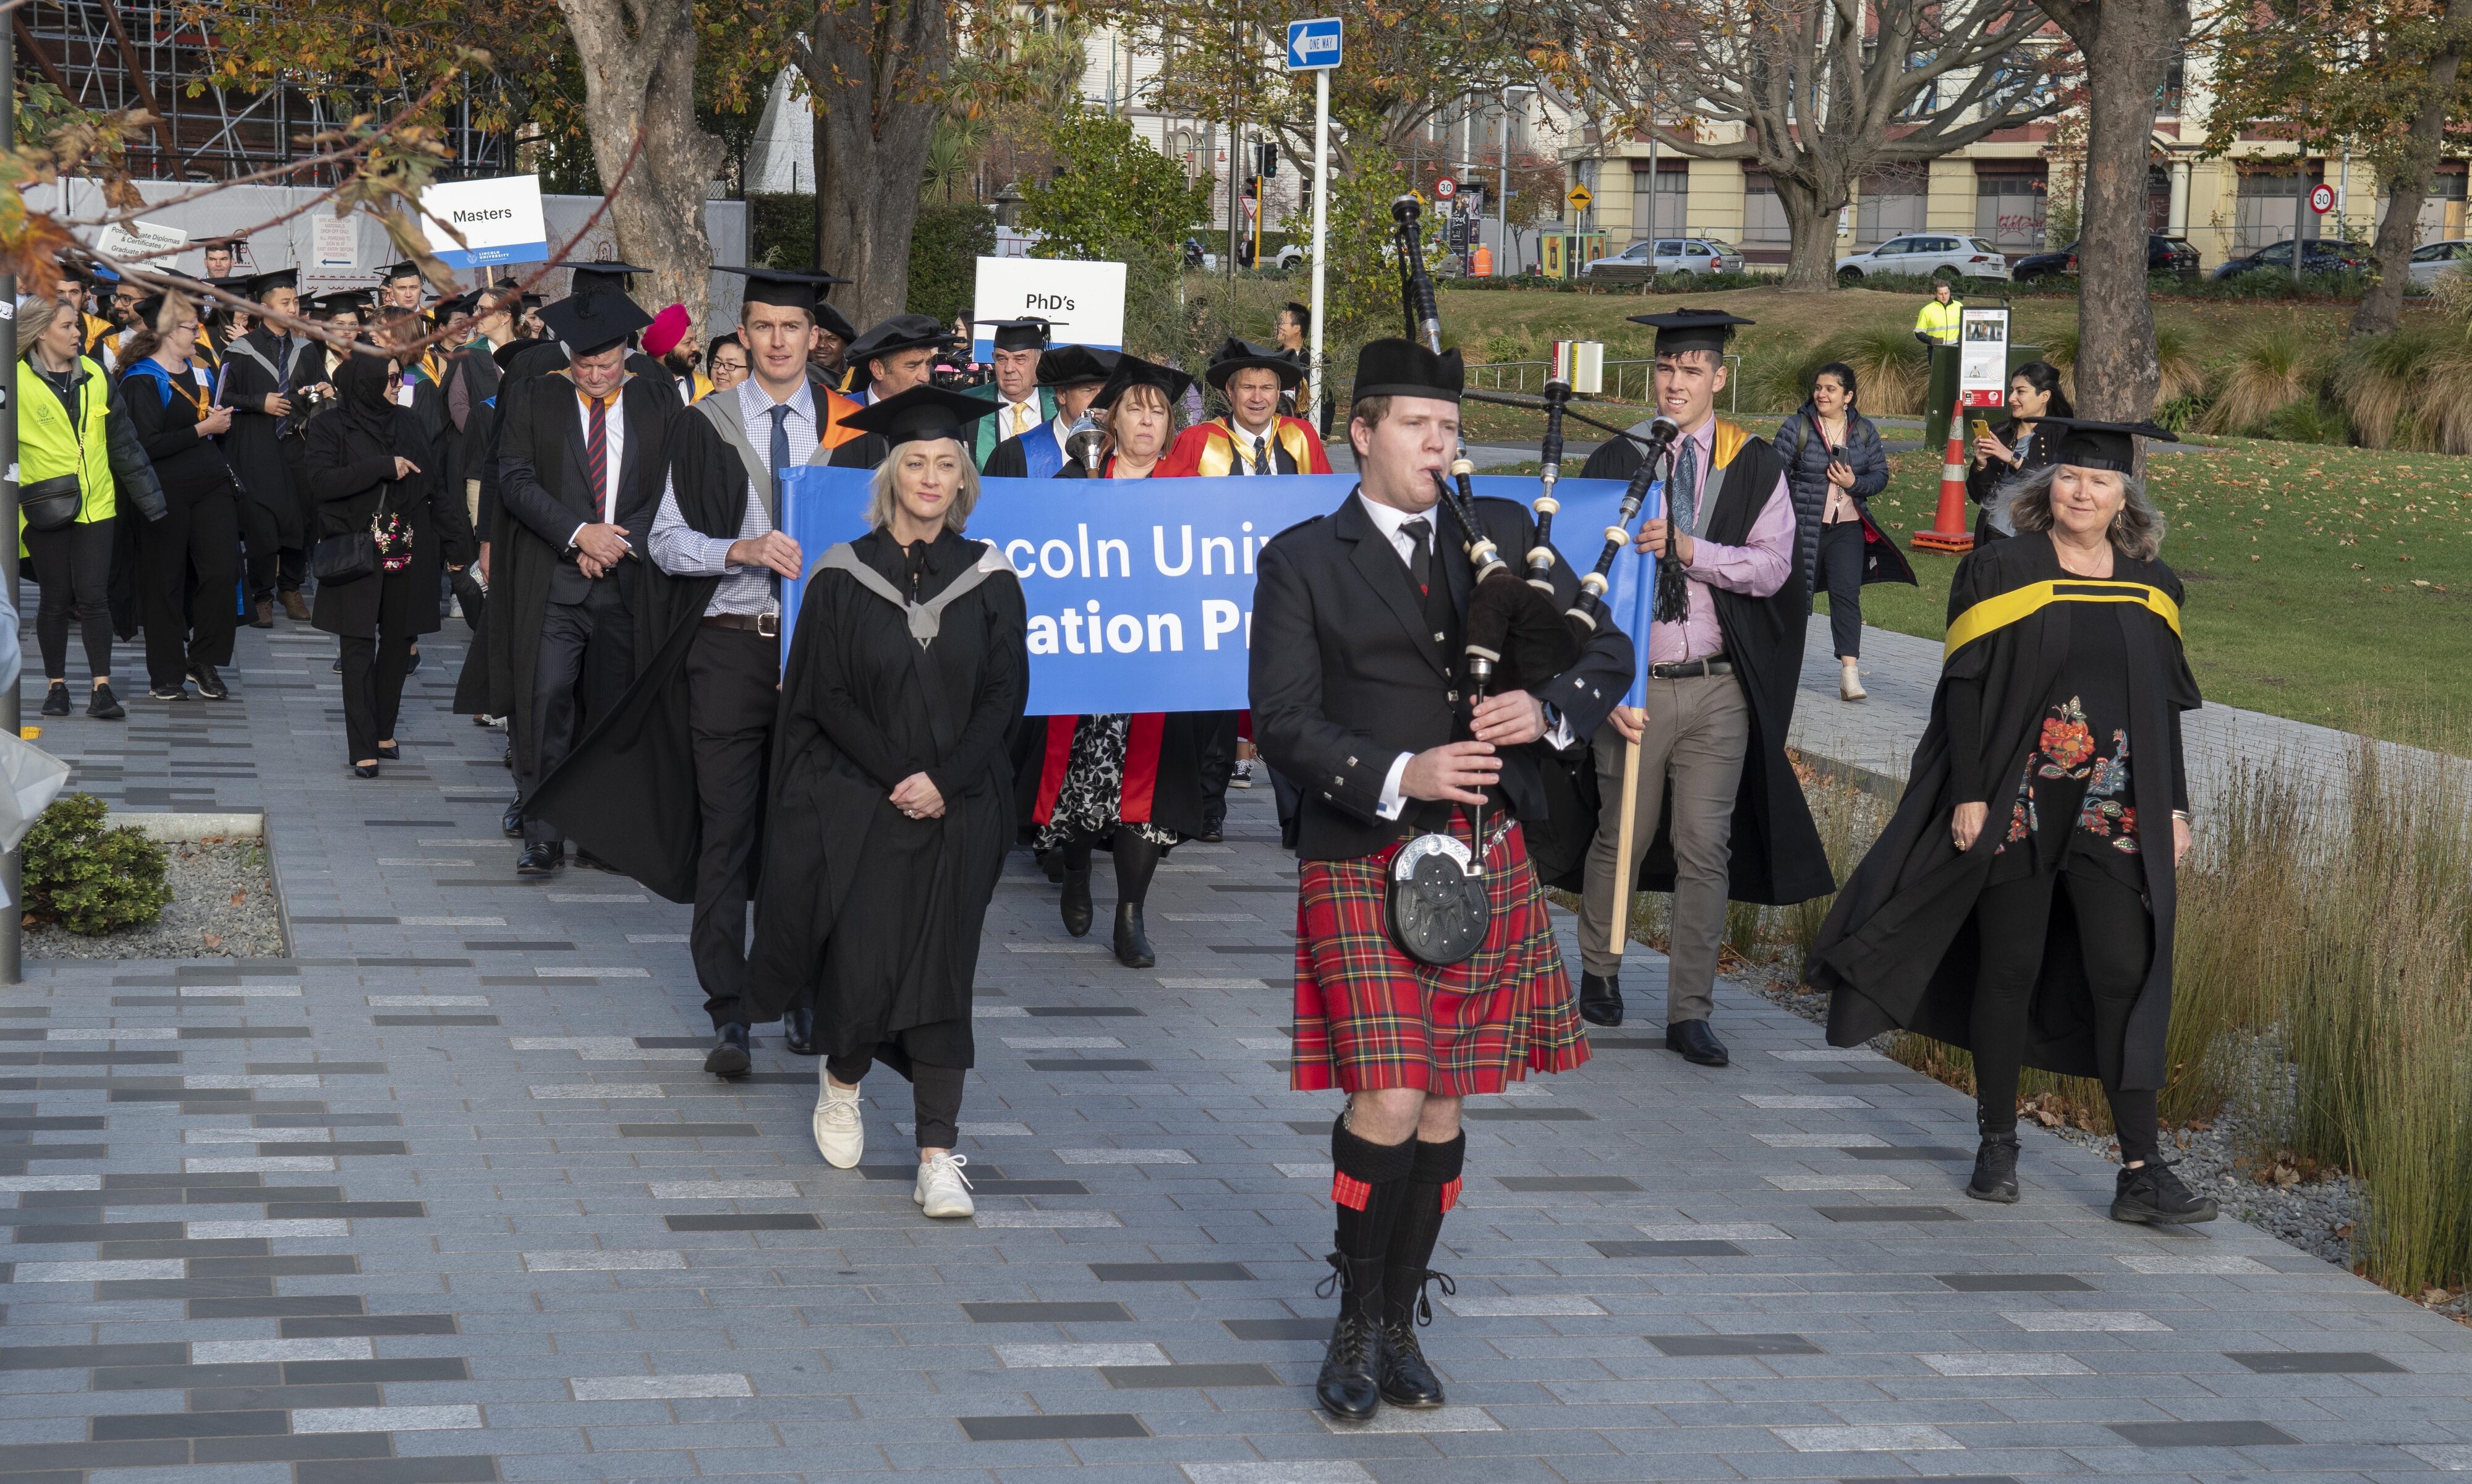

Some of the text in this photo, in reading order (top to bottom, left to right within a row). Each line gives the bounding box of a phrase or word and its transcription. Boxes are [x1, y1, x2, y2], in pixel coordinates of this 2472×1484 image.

[1309, 37, 1332, 49] ONE WAY
[1440, 184, 1452, 192] 30
[2316, 193, 2329, 205] 30
[453, 208, 512, 223] Masters
[111, 226, 181, 245] Postguate Diplomas
[127, 237, 161, 249] Certificates
[111, 245, 139, 255] Graduate
[1026, 293, 1075, 310] PhD's
[971, 521, 1270, 579] coln Uni
[1027, 599, 1184, 655] ation
